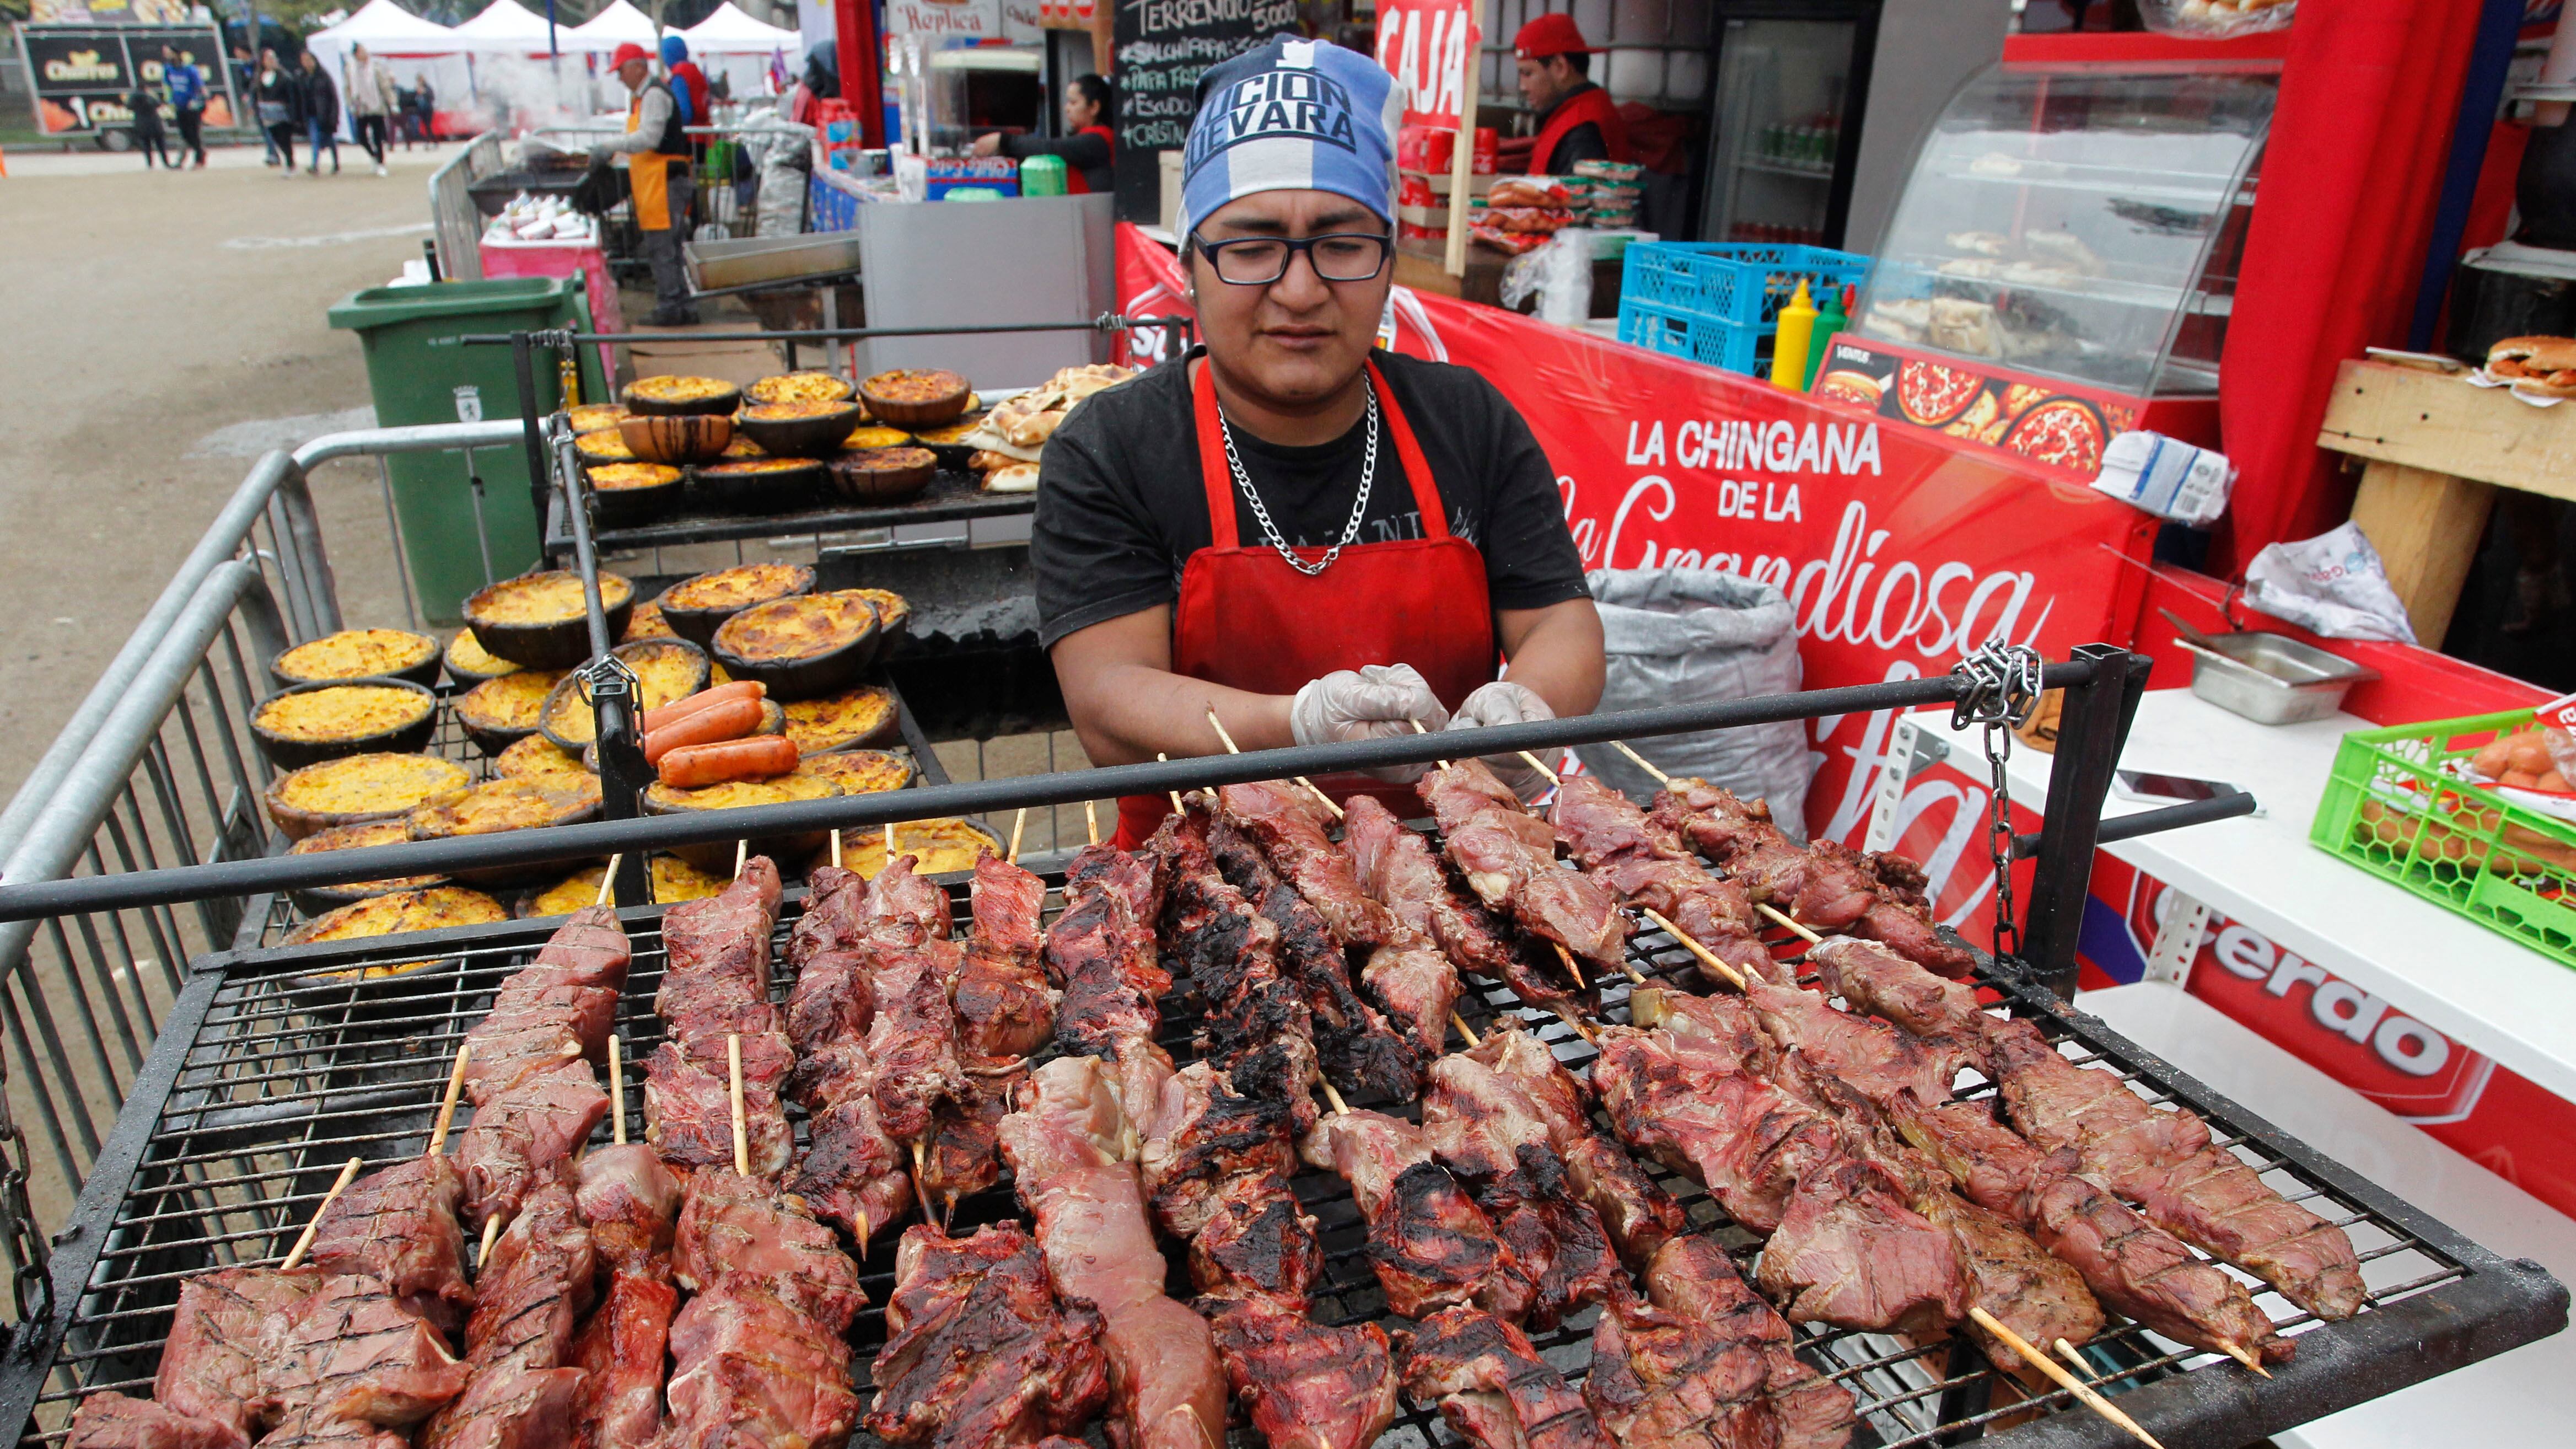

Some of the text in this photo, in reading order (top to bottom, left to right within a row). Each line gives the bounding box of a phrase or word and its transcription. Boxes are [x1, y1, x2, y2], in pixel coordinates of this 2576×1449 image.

[1378, 6, 1469, 116] CAJA
[1626, 419, 1881, 476] LA CHINGANA
[1718, 479, 1801, 523] DE LA
